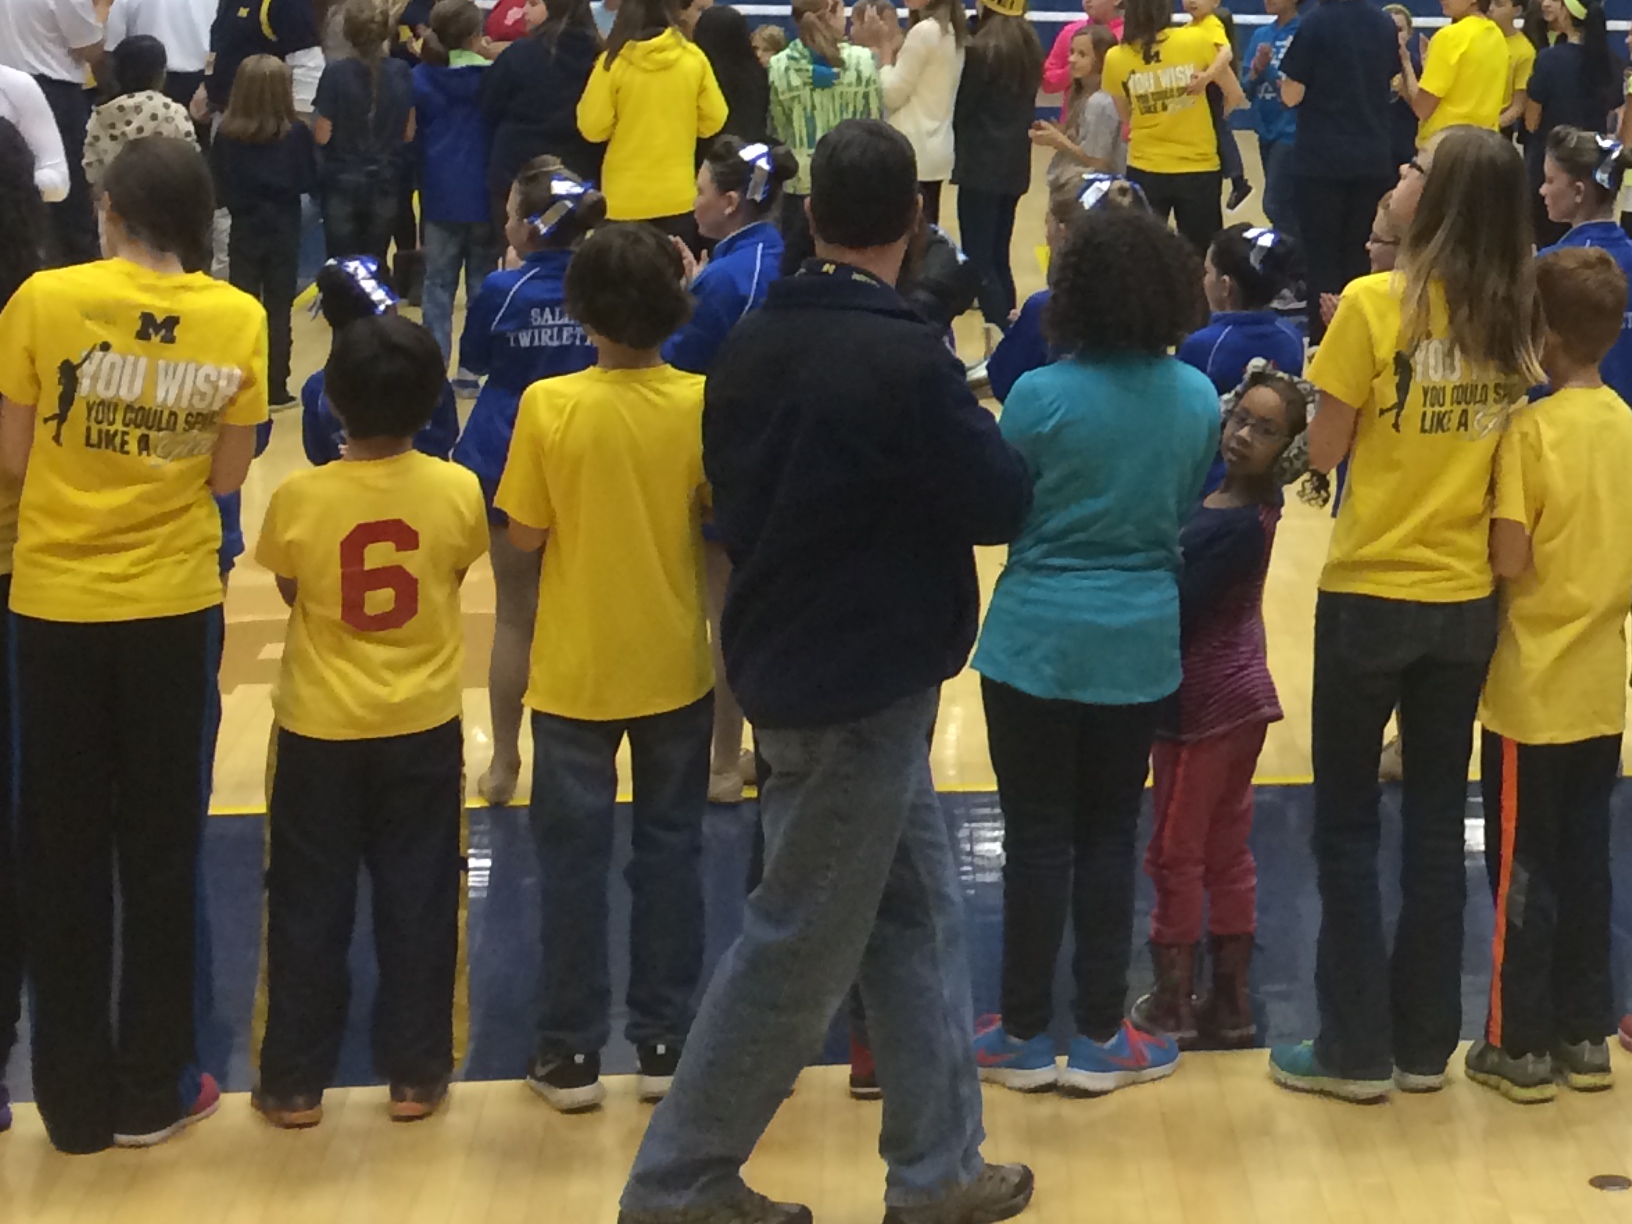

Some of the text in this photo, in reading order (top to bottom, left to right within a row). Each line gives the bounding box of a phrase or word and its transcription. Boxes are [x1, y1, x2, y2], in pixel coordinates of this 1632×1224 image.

[134, 311, 180, 344] M
[80, 351, 147, 401] YOU
[1410, 339, 1461, 383] YOU
[1421, 384, 1447, 408] YOU
[1450, 383, 1488, 407] COULD
[85, 400, 118, 427] YOU
[122, 403, 179, 431] COULD
[1420, 409, 1453, 434] LIKE
[1456, 408, 1469, 432] A
[84, 426, 130, 455] LIKE
[137, 433, 150, 456] A
[340, 518, 420, 632] 6
